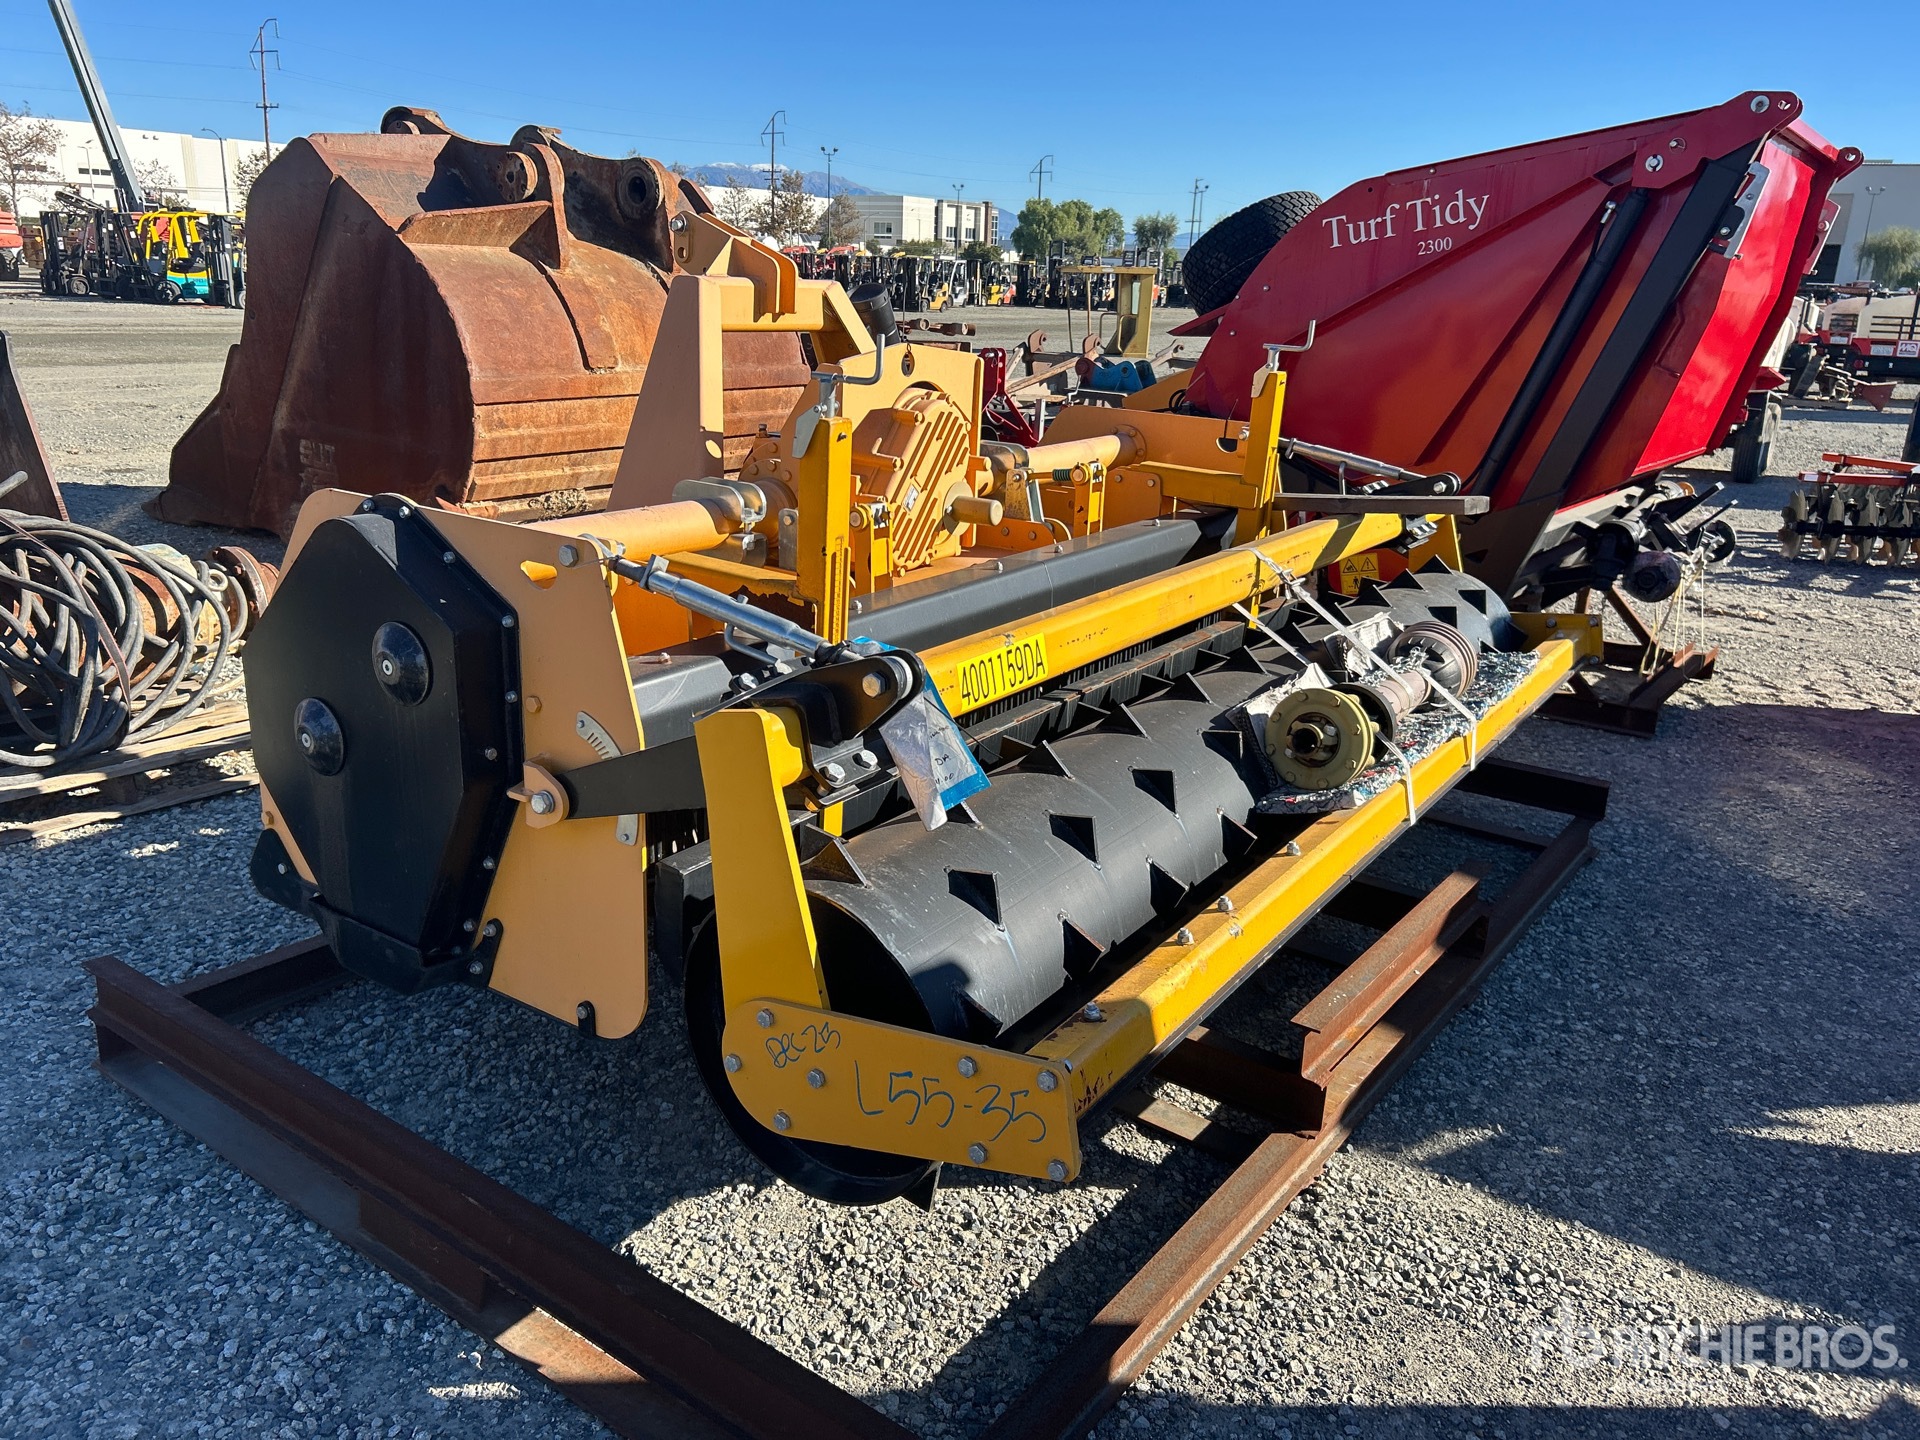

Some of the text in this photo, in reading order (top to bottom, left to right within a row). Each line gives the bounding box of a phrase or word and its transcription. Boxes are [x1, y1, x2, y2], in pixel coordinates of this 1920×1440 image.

[1322, 188, 1490, 249] Turf Tidy
[1417, 236, 1453, 255] 2300
[961, 638, 1046, 706] 4001159DA
